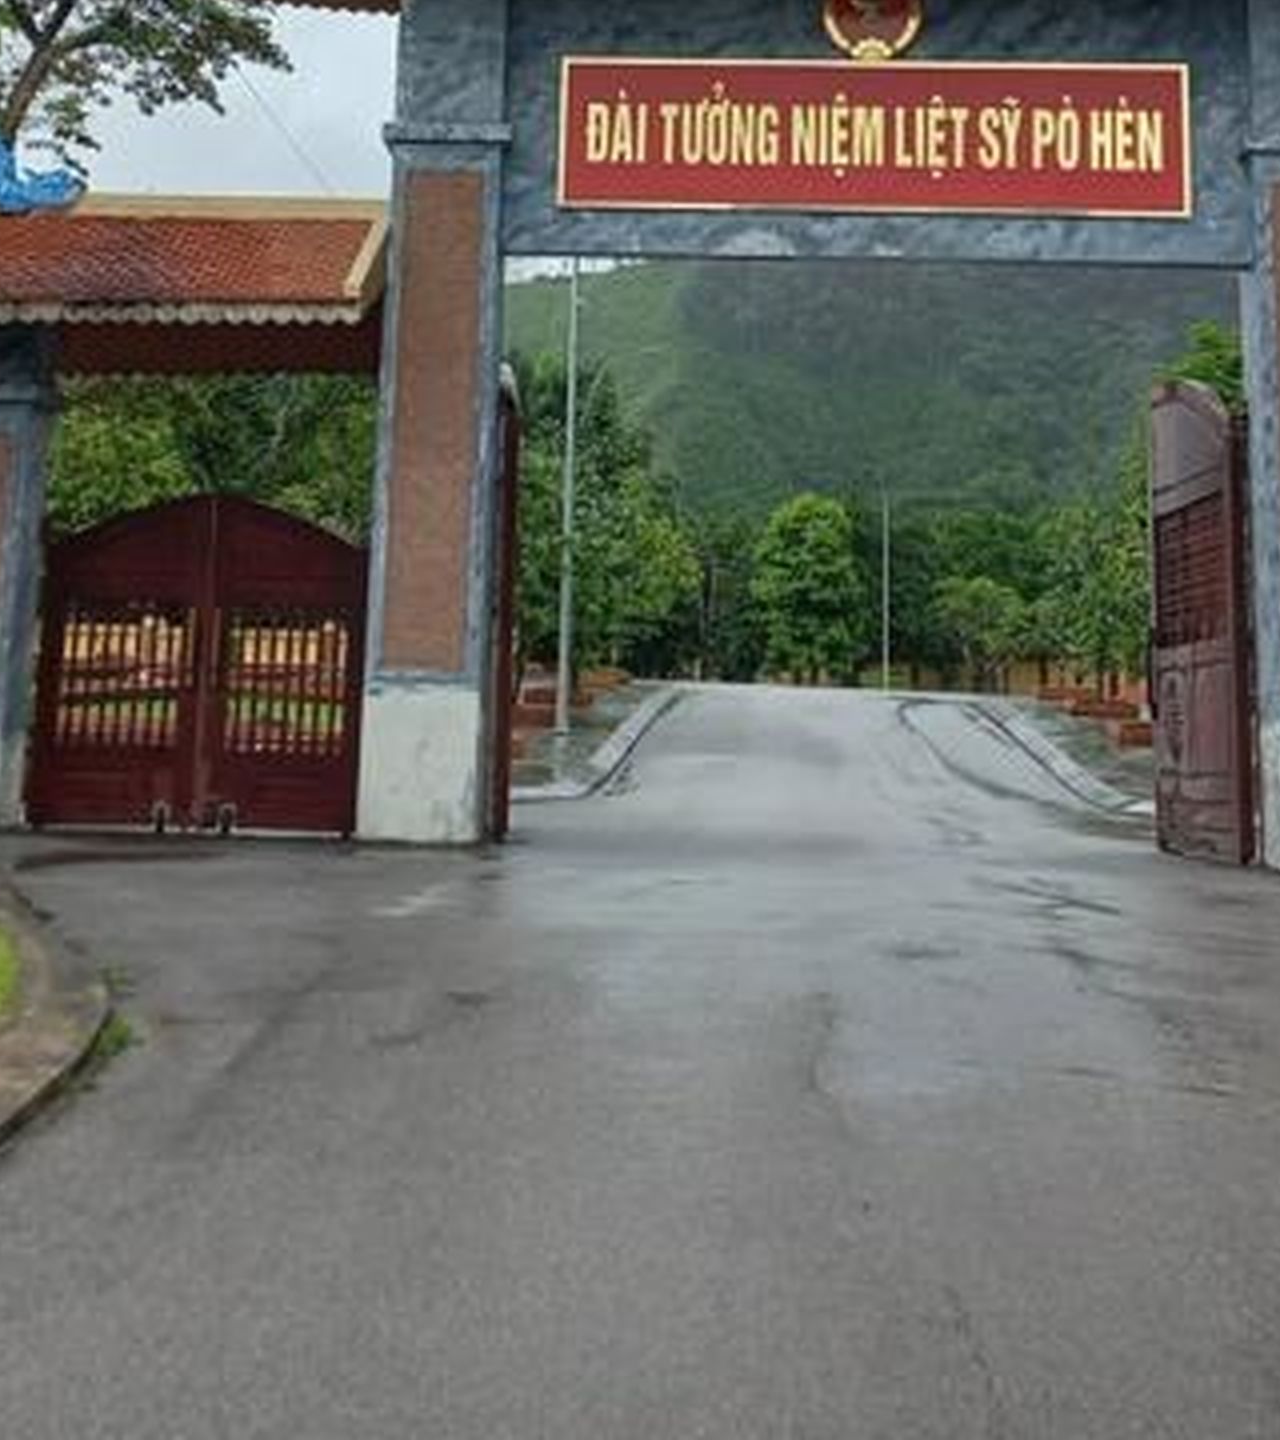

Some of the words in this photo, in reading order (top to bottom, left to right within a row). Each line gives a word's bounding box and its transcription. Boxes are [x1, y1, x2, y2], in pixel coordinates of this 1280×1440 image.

[585, 88, 648, 163] ĐÀI
[659, 80, 780, 165] TƯỞNG
[791, 93, 885, 178] NIỆM
[895, 94, 969, 179] LIỆT
[978, 96, 1021, 169] SỸ
[1090, 95, 1163, 171] HÈN
